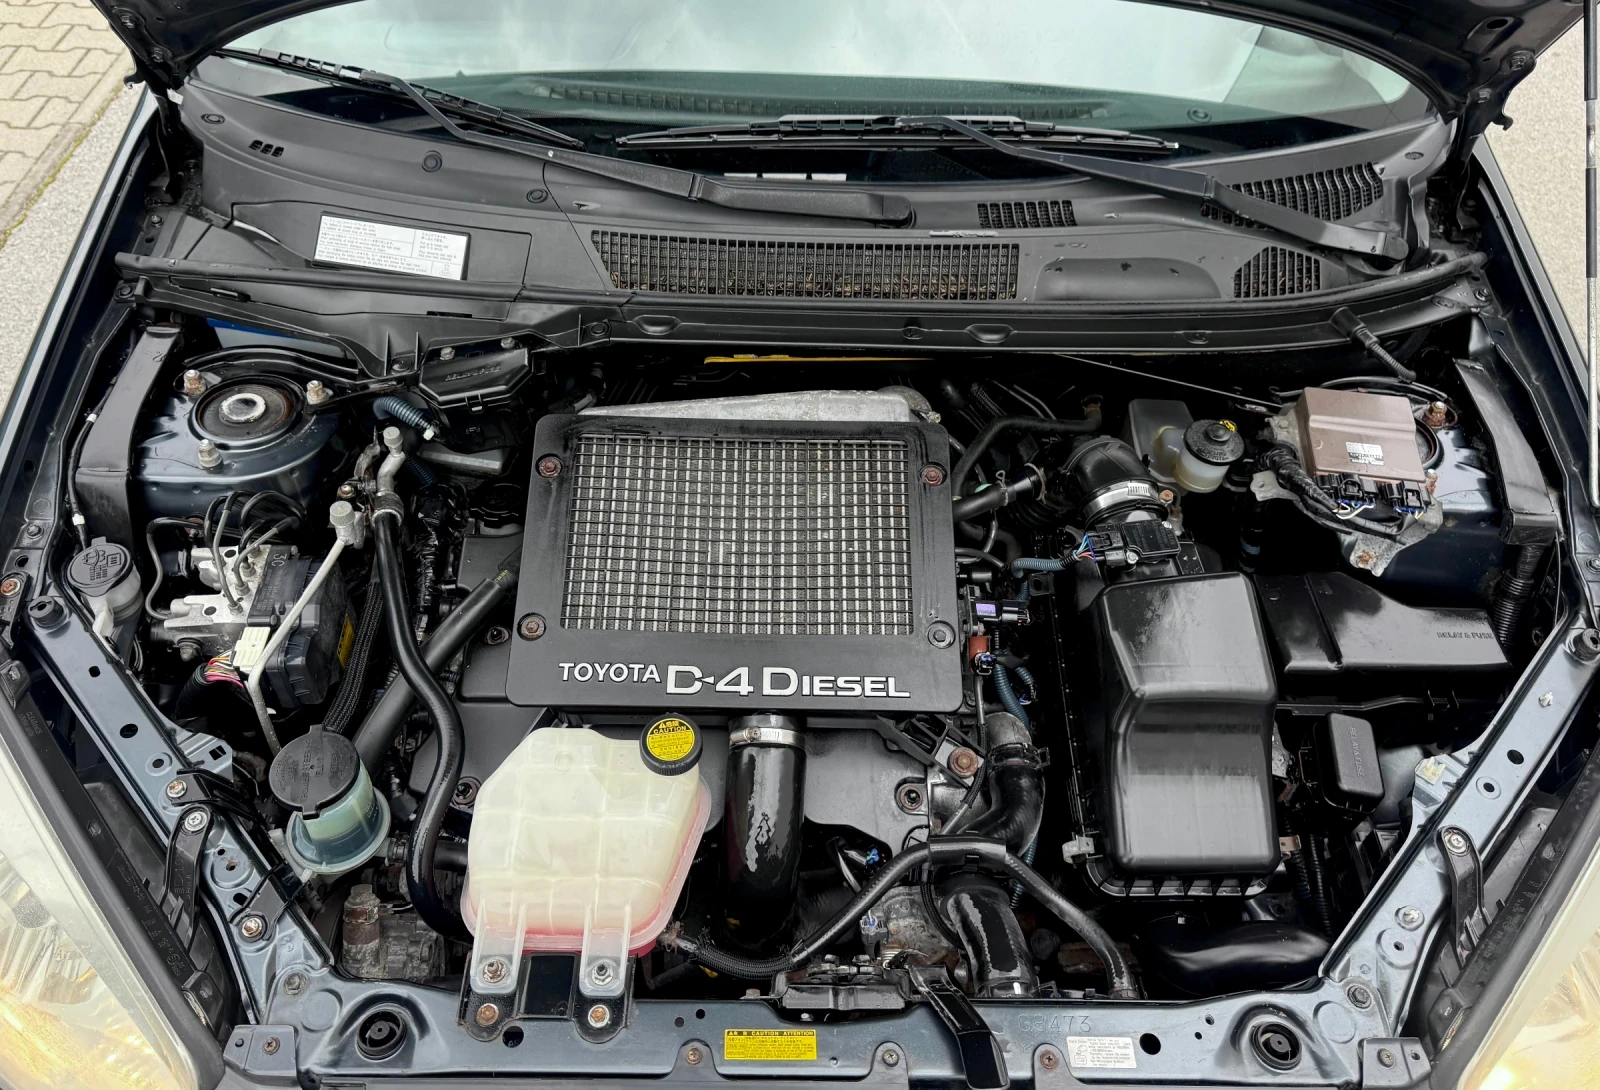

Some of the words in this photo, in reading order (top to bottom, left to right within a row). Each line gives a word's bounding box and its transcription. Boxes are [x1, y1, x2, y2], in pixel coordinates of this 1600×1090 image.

[558, 662, 662, 684] TOYOTA
[666, 665, 754, 697] D-4
[653, 725, 687, 735] CAUTION
